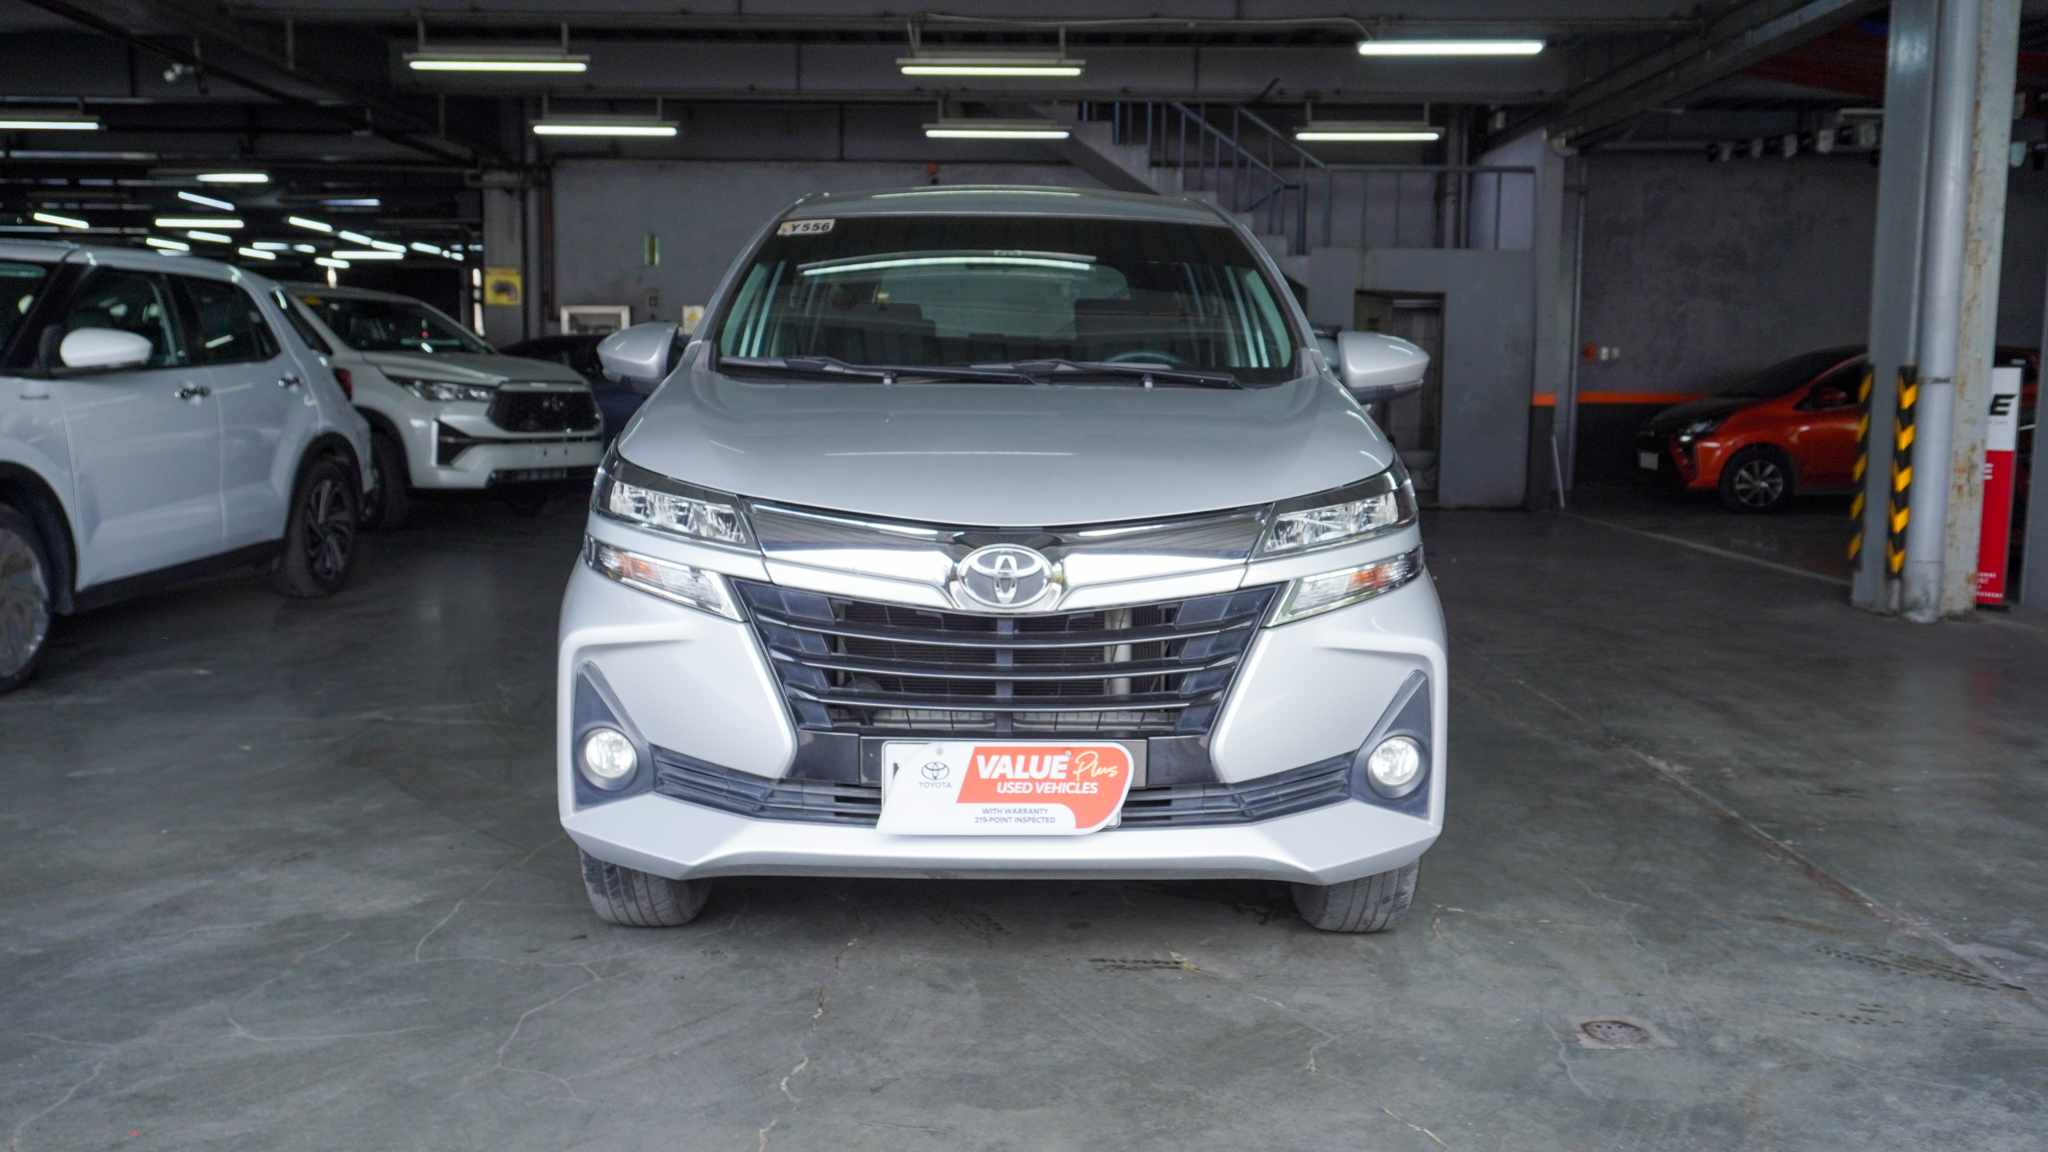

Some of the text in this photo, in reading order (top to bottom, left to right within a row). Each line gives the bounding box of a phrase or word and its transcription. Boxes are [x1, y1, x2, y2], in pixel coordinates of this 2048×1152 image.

[976, 750, 1119, 781] VALUE Plus
[997, 782, 1099, 794] USED VEHICLES
